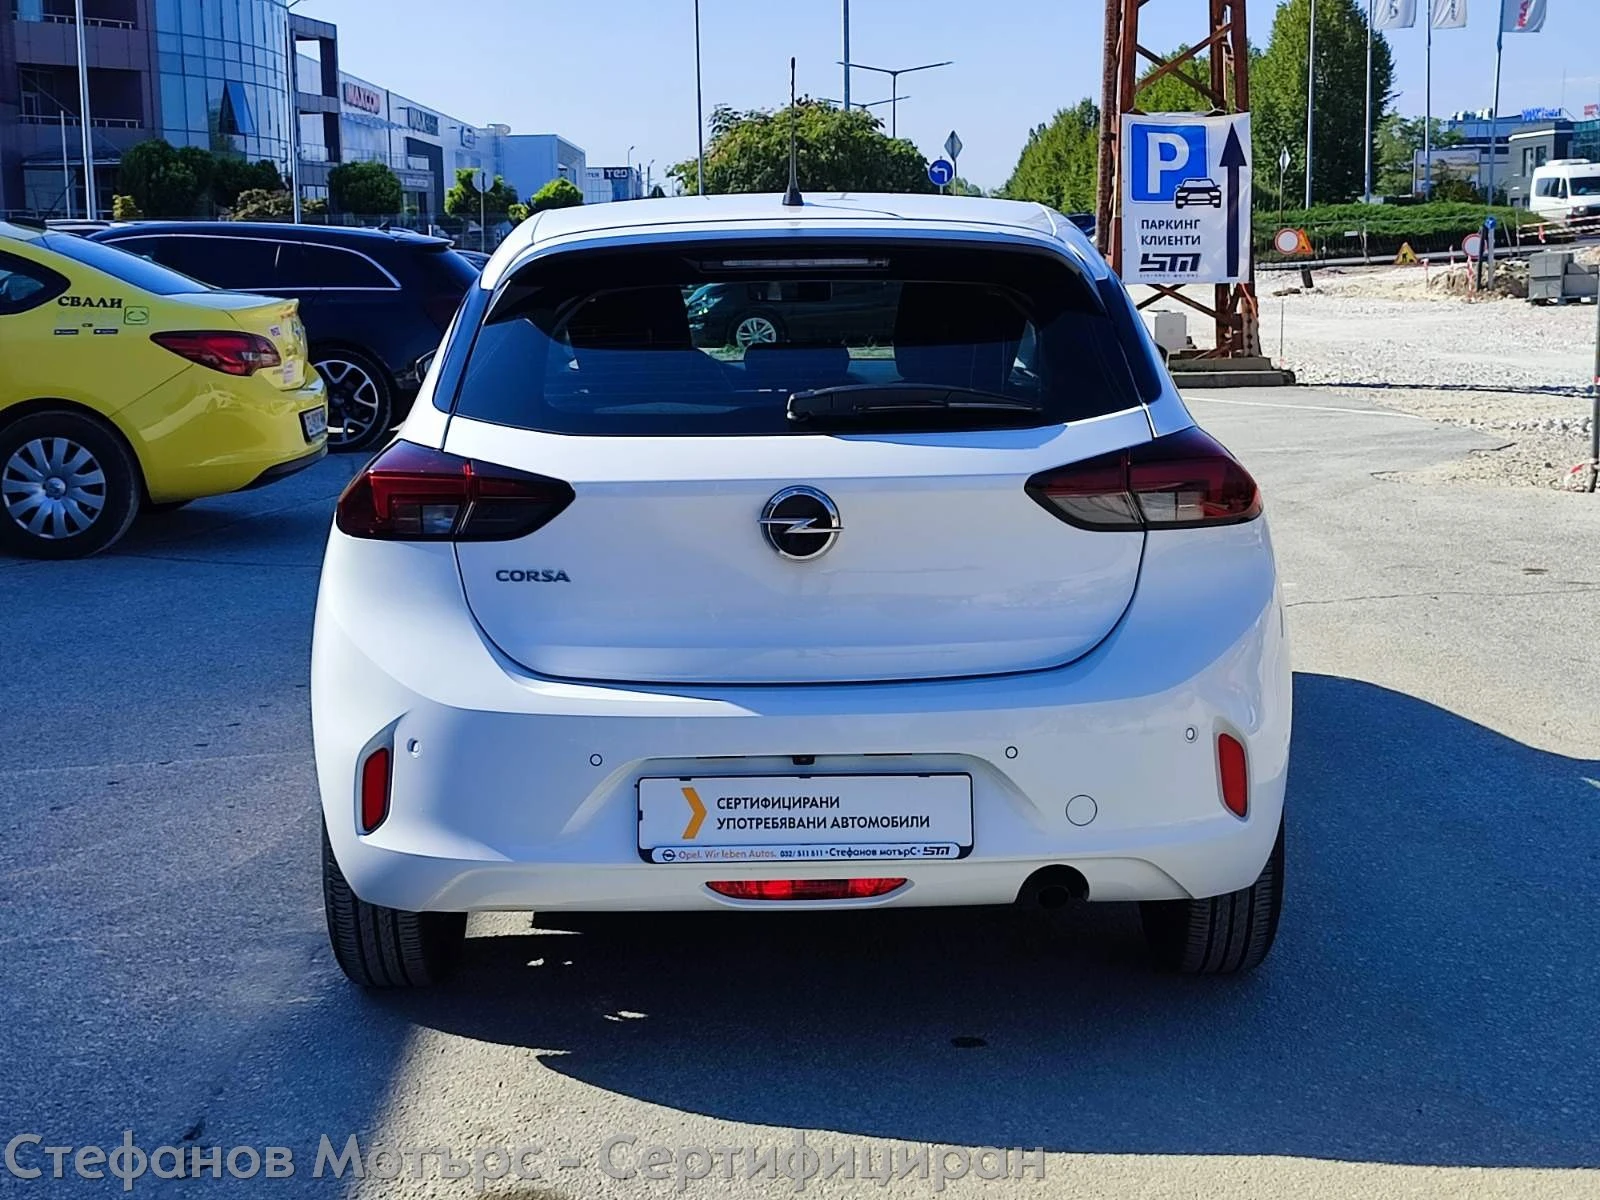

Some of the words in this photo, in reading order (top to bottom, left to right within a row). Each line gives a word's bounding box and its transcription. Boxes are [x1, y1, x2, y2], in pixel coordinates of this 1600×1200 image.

[1147, 132, 1190, 194] P
[1141, 219, 1201, 230] ПАРКИНГ
[1141, 235, 1201, 246] КЛИЕНТИ
[495, 569, 571, 583] CORSA
[716, 796, 840, 810] СЕРТИФИЦИРАНИ
[716, 816, 827, 829] УПОТРЕБЯВАНИ
[831, 815, 930, 828] АВТОМОБИЛИ
